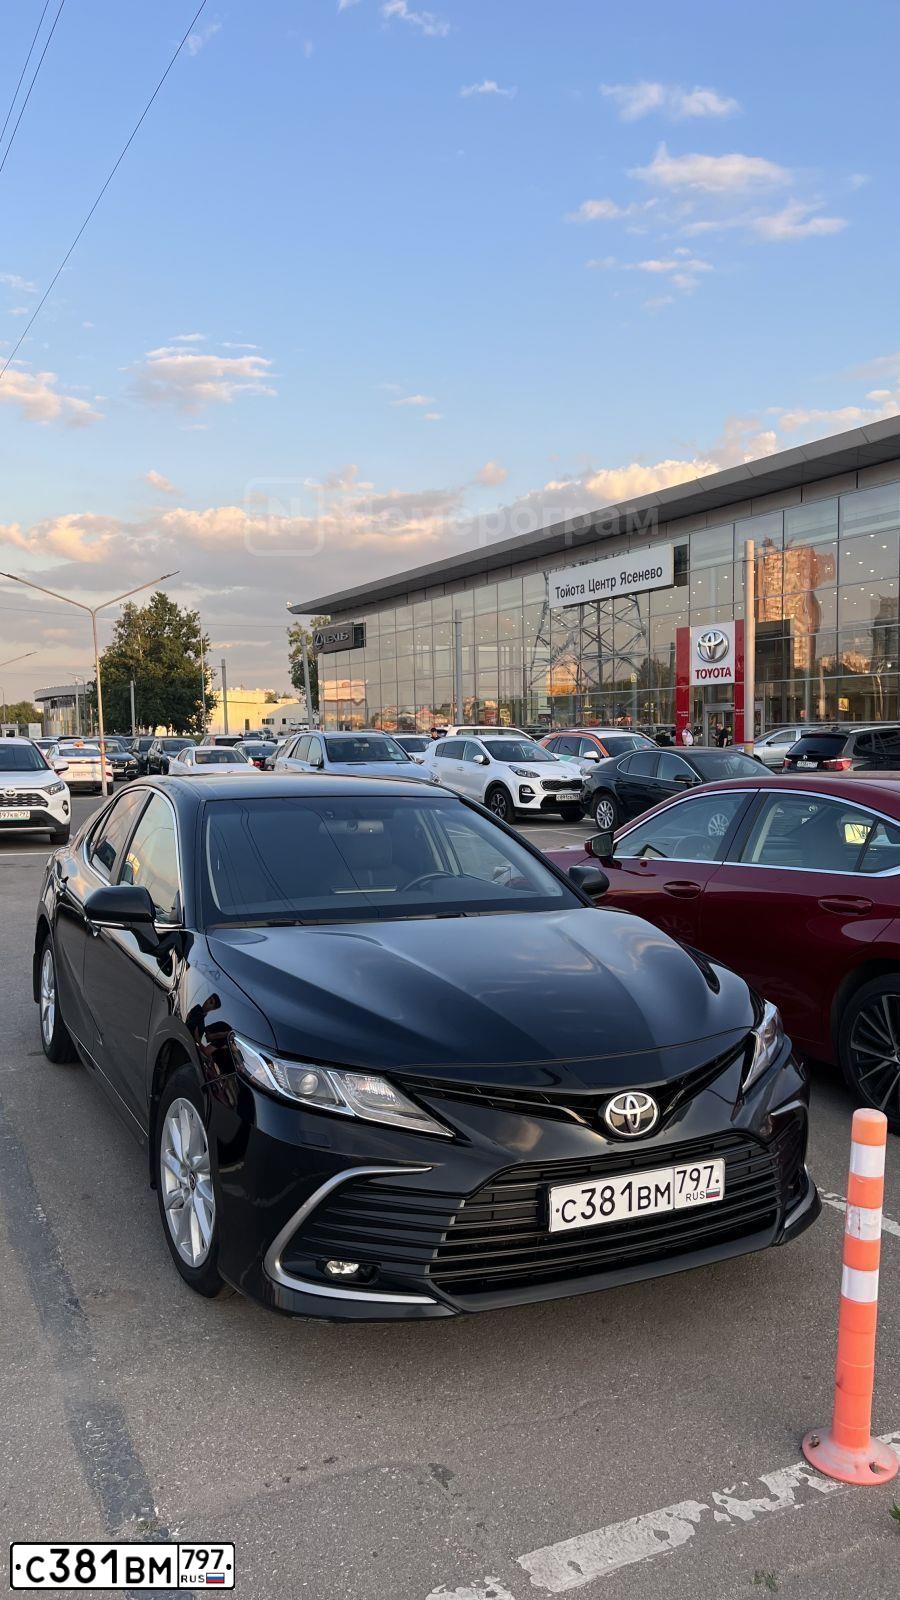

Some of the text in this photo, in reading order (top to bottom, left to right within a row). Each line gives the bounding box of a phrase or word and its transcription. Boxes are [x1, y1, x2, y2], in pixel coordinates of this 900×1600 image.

[555, 566, 663, 599] Тойота Центр Ясенево
[695, 666, 732, 680] TOYOTA
[676, 1165, 715, 1194] 797
[685, 1190, 705, 1202] RUS
